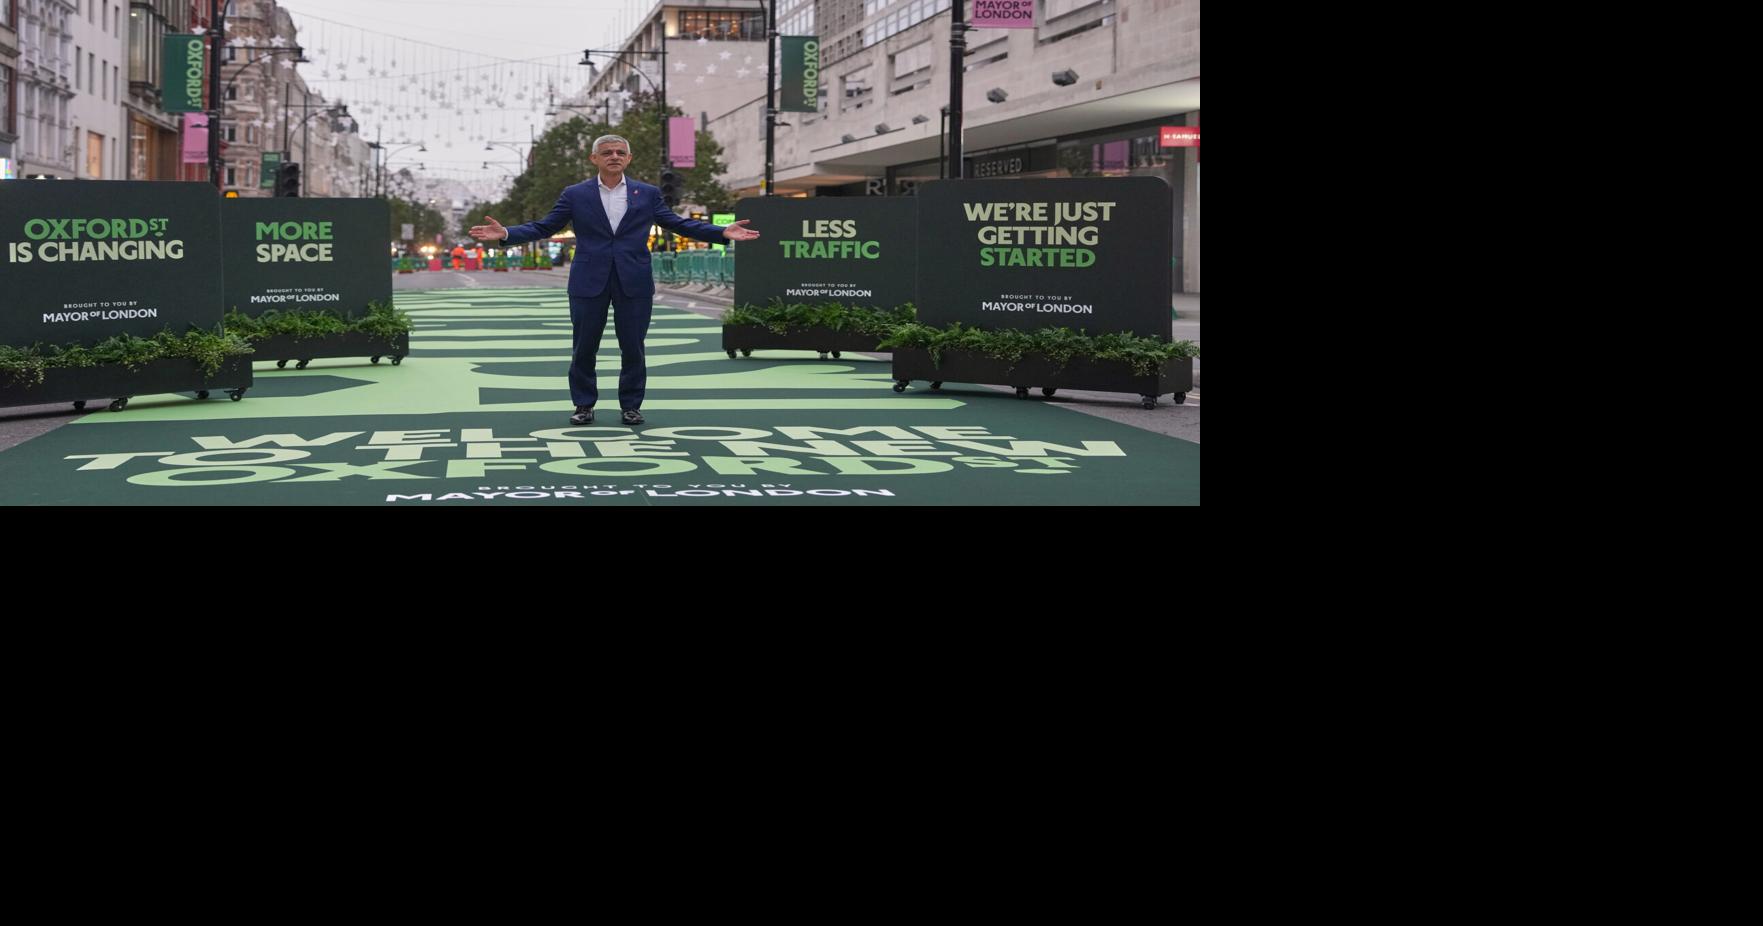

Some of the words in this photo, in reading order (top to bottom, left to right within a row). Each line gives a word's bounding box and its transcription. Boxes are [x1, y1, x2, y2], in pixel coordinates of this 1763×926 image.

[976, 0, 1020, 9] MAYOR
[976, 10, 1032, 19] LONDON
[186, 40, 204, 98] OXFORD
[804, 41, 818, 98] OXFORD
[976, 158, 1022, 177] RESERVED
[1054, 202, 1116, 226] JUST
[24, 218, 148, 240] OXFORD
[256, 222, 333, 240] MORE
[802, 220, 856, 238] LESS
[978, 226, 1098, 246] GETTING
[9, 242, 33, 263] IS
[38, 240, 184, 262] CHANGING
[256, 243, 333, 263] SPACE
[779, 240, 880, 259] TRAFFIC
[980, 247, 1096, 267] STARTED
[250, 295, 286, 303] MAYOR
[296, 293, 340, 302] LONDON
[786, 289, 819, 297] MAYOR
[43, 312, 89, 323] MAYOR
[102, 308, 157, 320] LONDON
[982, 302, 1024, 311] MAYOR
[1036, 303, 1092, 314] LONDON
[190, 426, 1017, 450] WELCOME
[64, 449, 312, 471] TO
[354, 440, 691, 461] THE
[717, 440, 1127, 456] NEW
[126, 456, 954, 486] OXFORD
[385, 490, 582, 502] MAYOR
[646, 488, 896, 497] LONDON
